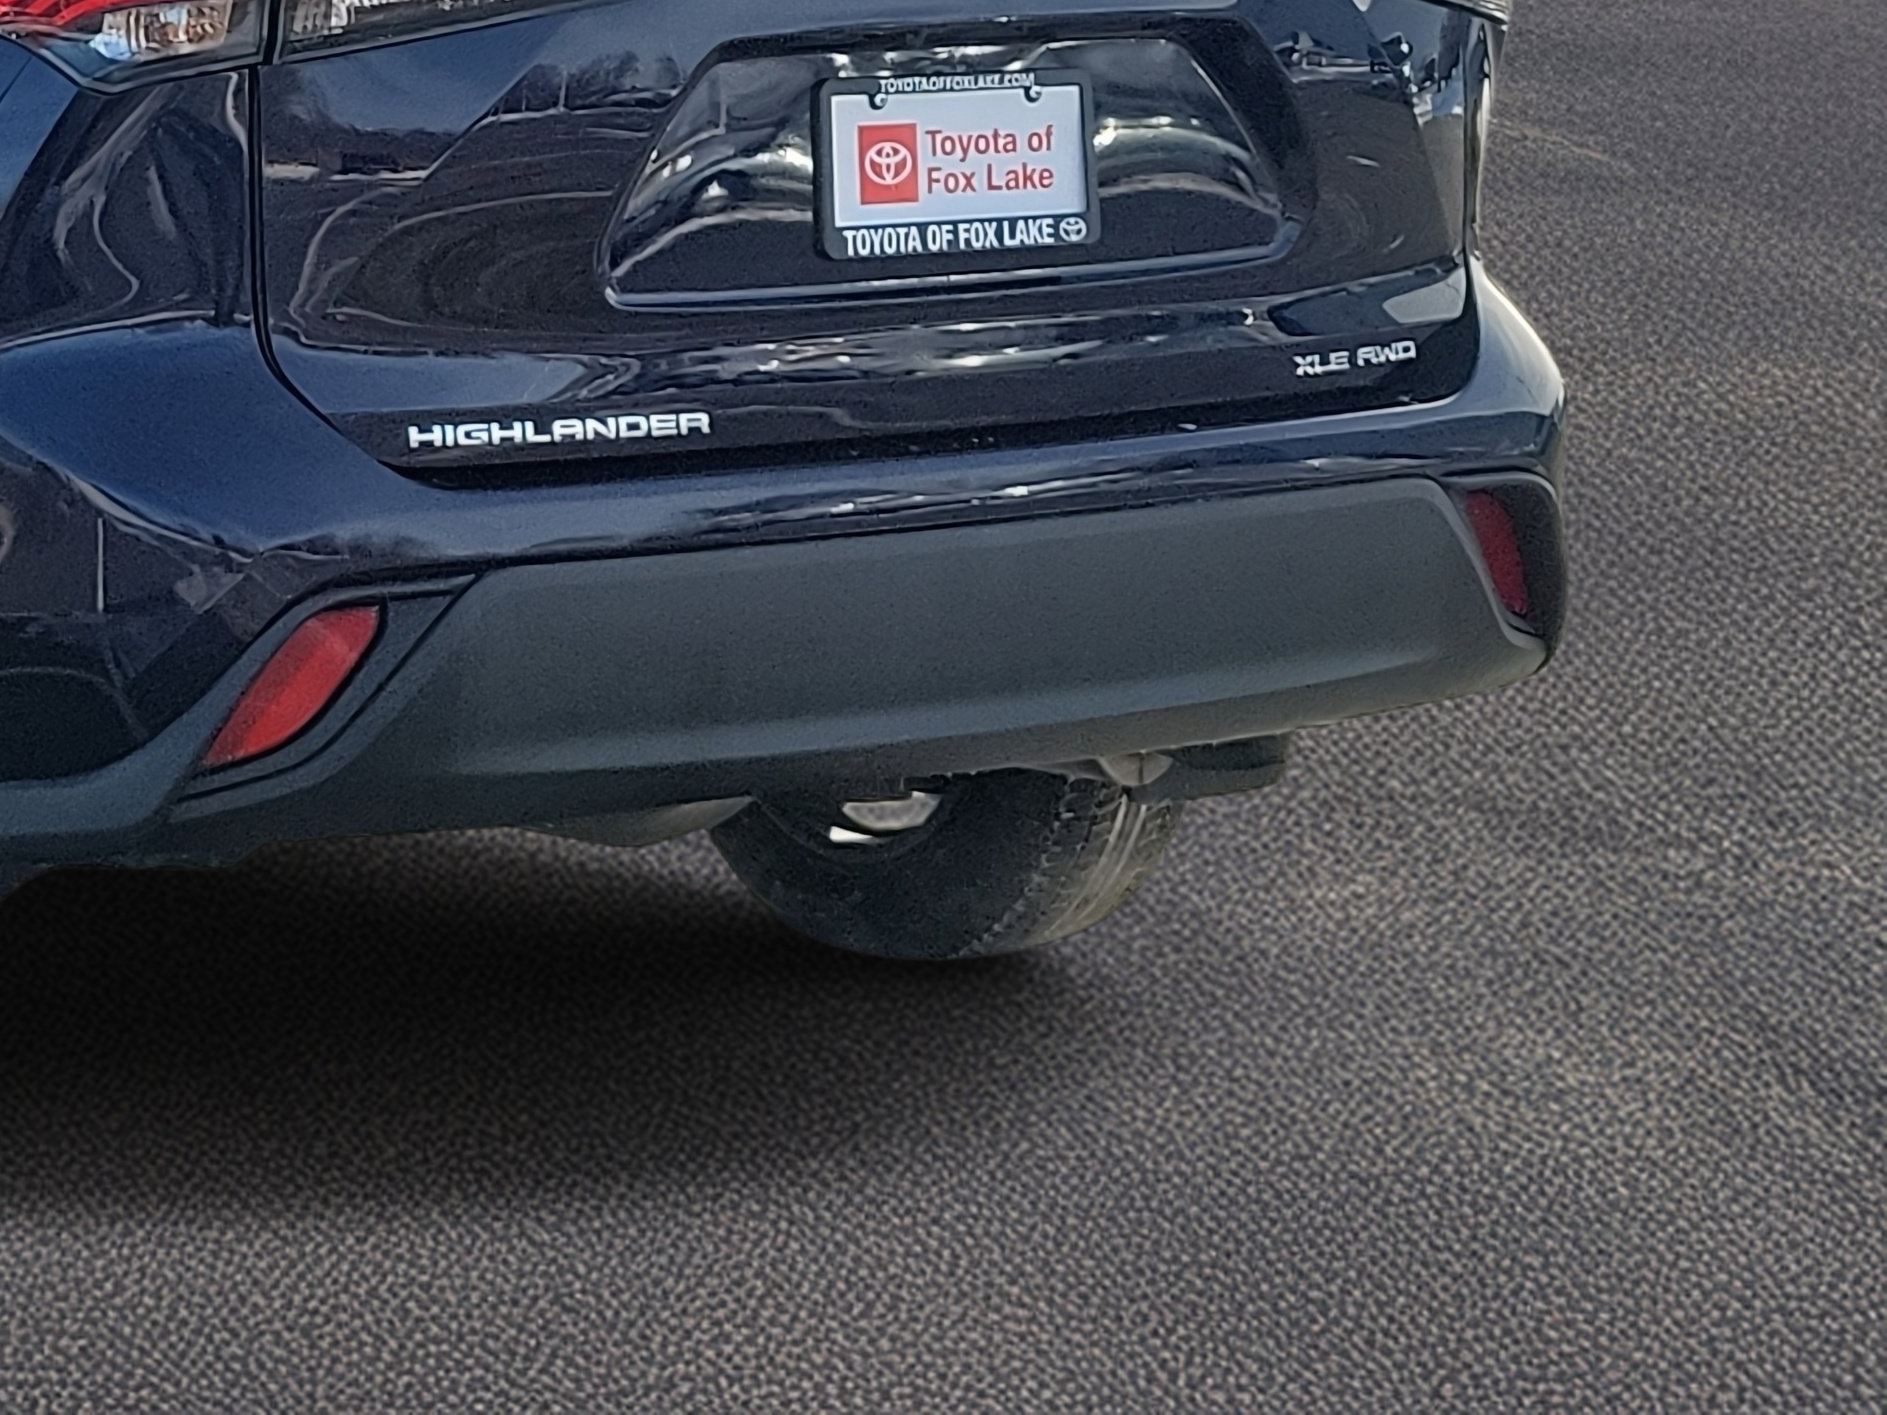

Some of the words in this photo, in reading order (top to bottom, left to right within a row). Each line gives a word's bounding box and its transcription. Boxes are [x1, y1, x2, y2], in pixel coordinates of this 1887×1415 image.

[878, 73, 1035, 93] TOYOTAOFFOXLAKE.COM
[924, 129, 1018, 163] Toyota
[1027, 124, 1055, 153] of
[927, 166, 978, 195] Fox
[986, 162, 1055, 192] Lake
[843, 225, 921, 257] TOYOTA
[926, 223, 953, 251] OF
[958, 220, 999, 250] FOX
[1002, 217, 1056, 246] LAKE
[1292, 350, 1351, 377] XLE
[1356, 340, 1417, 367] AWD
[407, 411, 711, 449] HIGHLANDER
